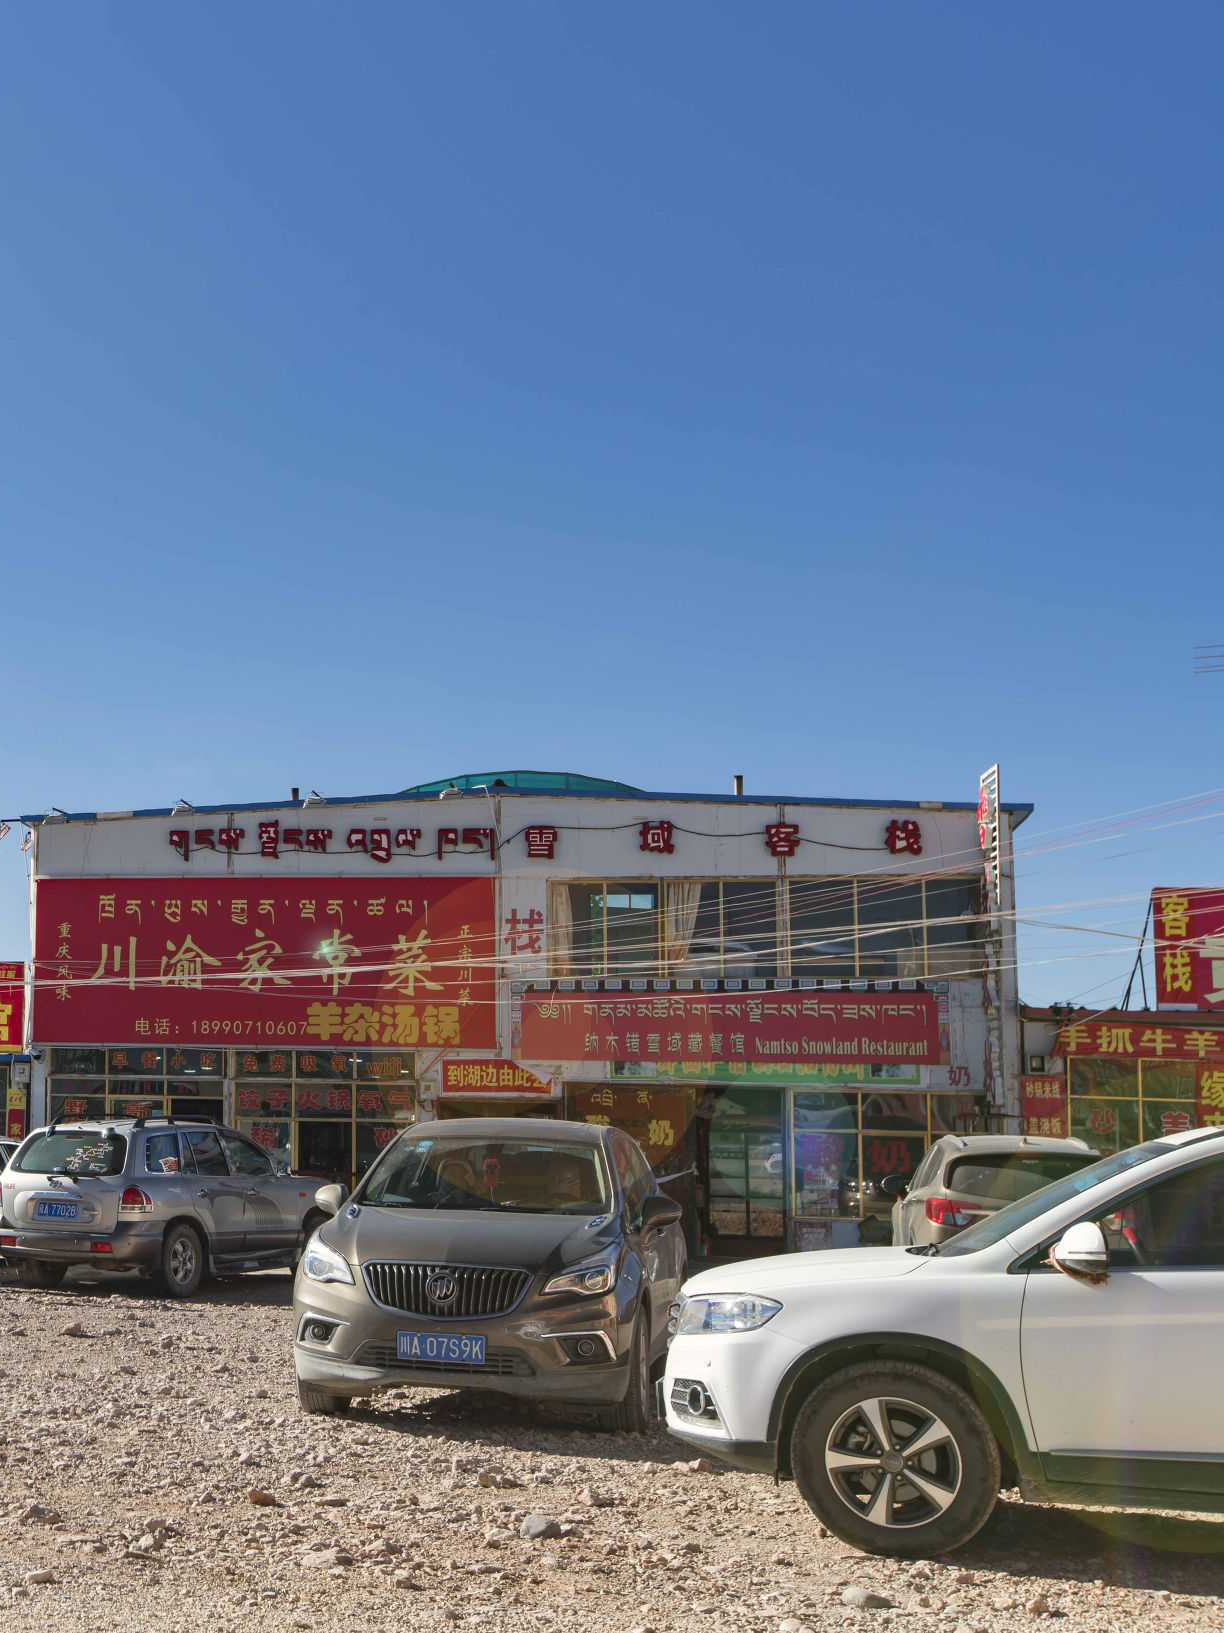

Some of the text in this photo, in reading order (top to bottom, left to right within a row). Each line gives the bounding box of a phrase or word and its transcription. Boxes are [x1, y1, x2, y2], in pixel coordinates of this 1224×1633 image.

[525, 820, 923, 859] 雪域客栈
[505, 909, 544, 955] 栈
[1161, 895, 1193, 993] 客栈
[55, 922, 73, 1001] 重庆风味
[90, 928, 445, 997] 川渝家常菜
[457, 925, 474, 1007] 正宗川菜
[306, 1002, 461, 1045] 羊杂汤锅
[584, 1031, 928, 1057] 纳木错雪域藏餐馆 Namtso Snowland Restaurant
[1059, 1025, 1220, 1057] 手抓牛羊
[243, 1055, 348, 1073] 免费吸氧
